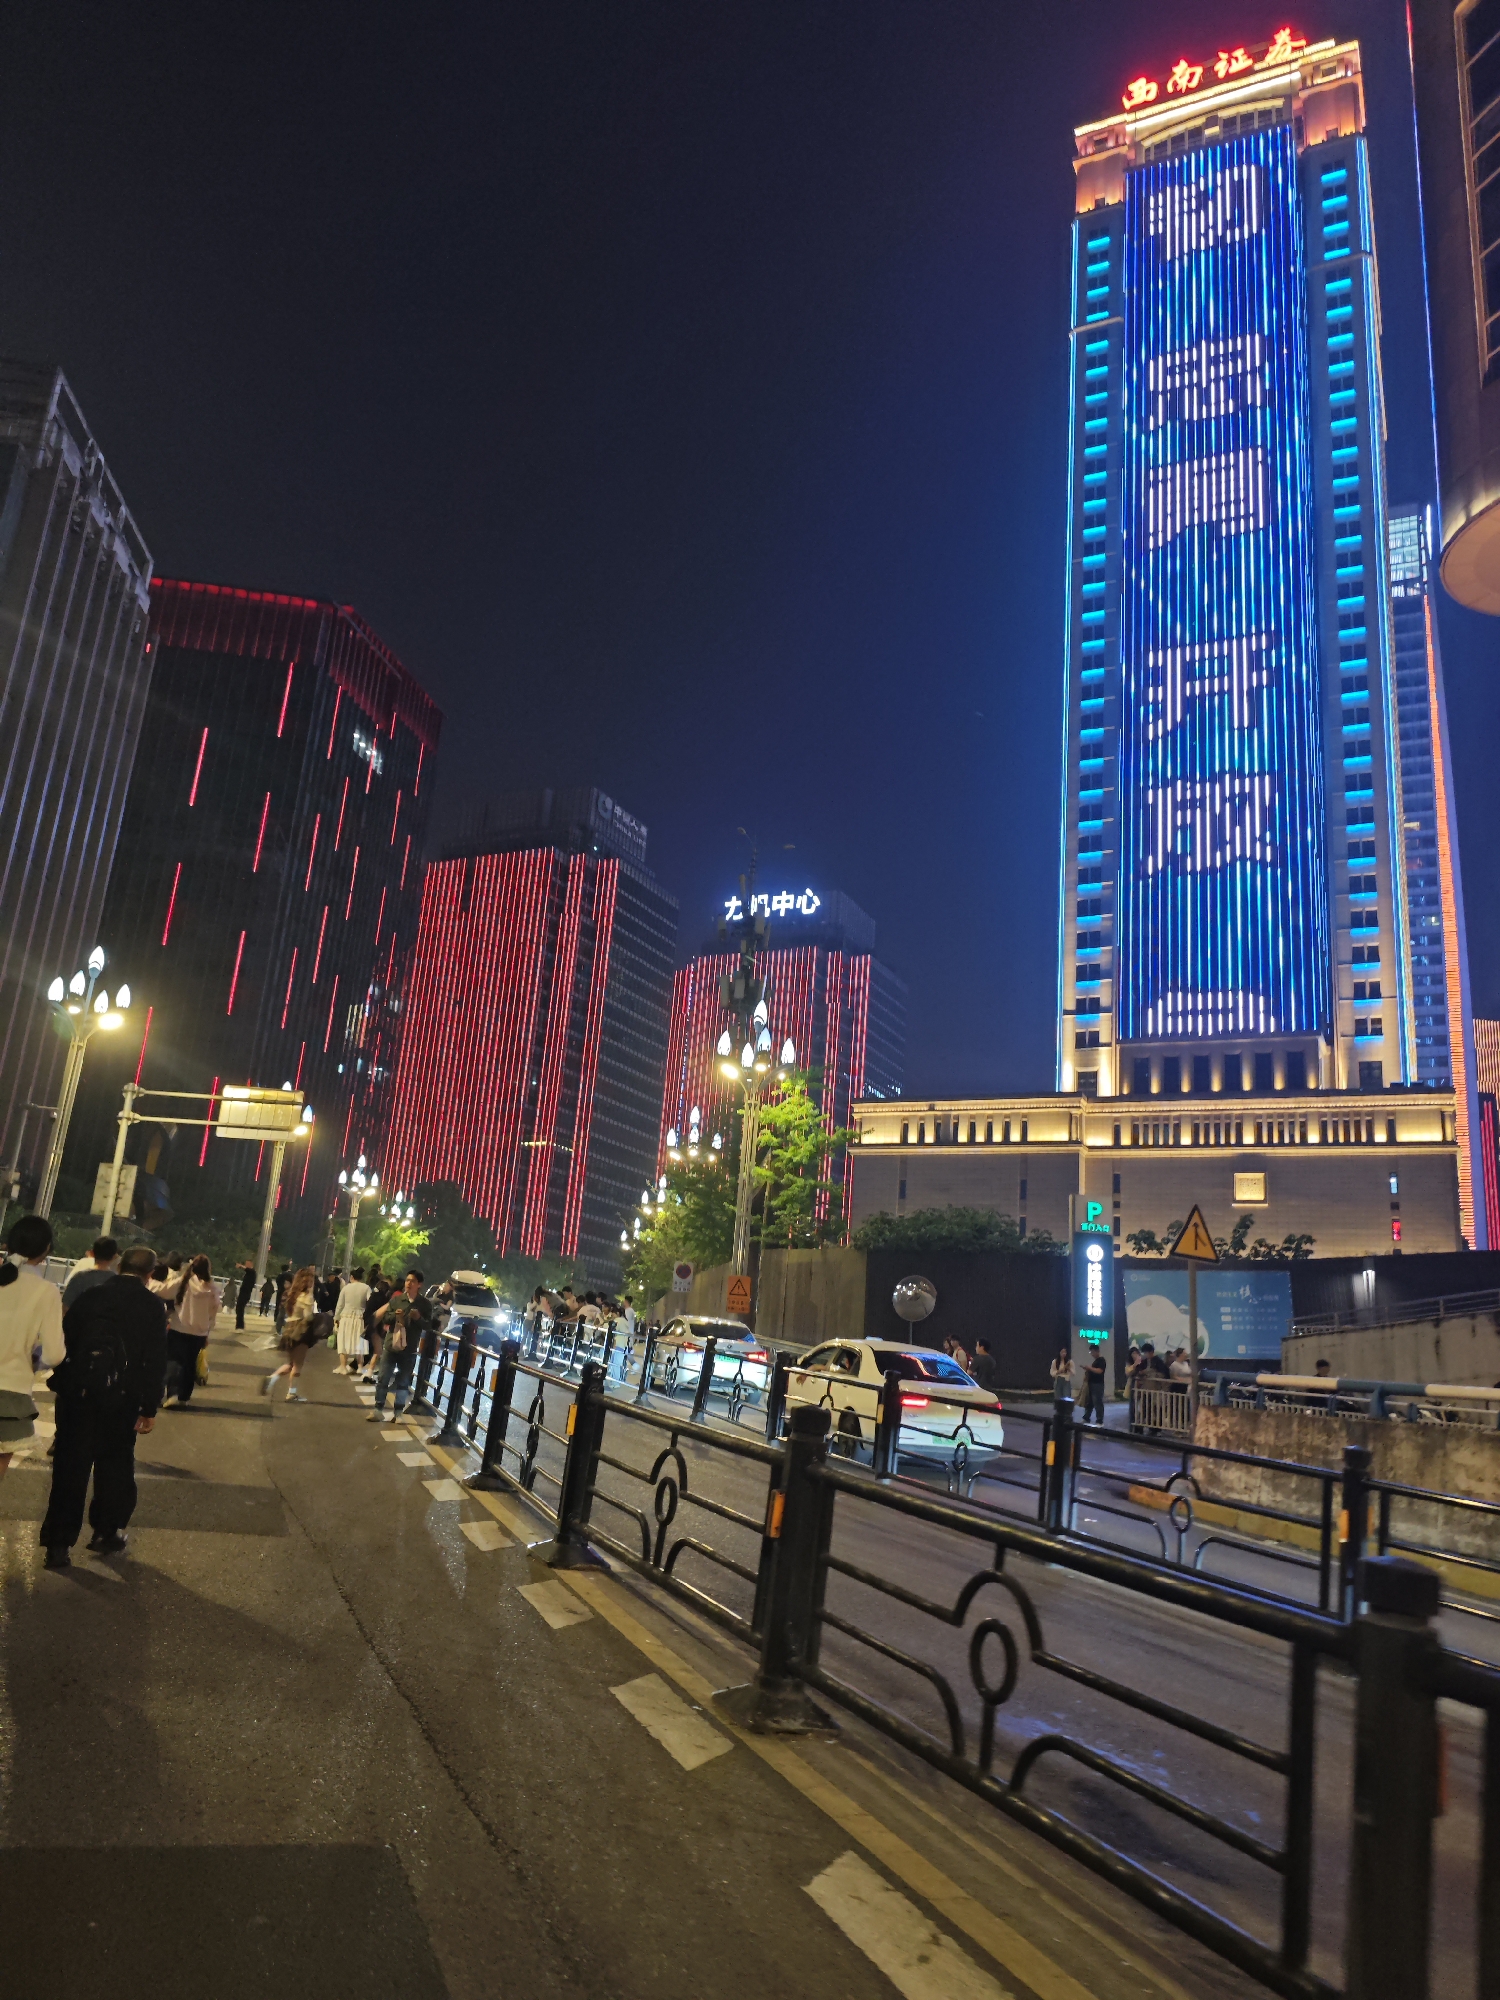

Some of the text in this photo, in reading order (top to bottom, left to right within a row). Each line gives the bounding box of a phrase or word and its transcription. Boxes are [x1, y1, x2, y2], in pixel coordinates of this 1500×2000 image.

[1121, 26, 1306, 109] 西南证券
[1148, 631, 1273, 876] 开放
[1087, 1201, 1103, 1222] P
